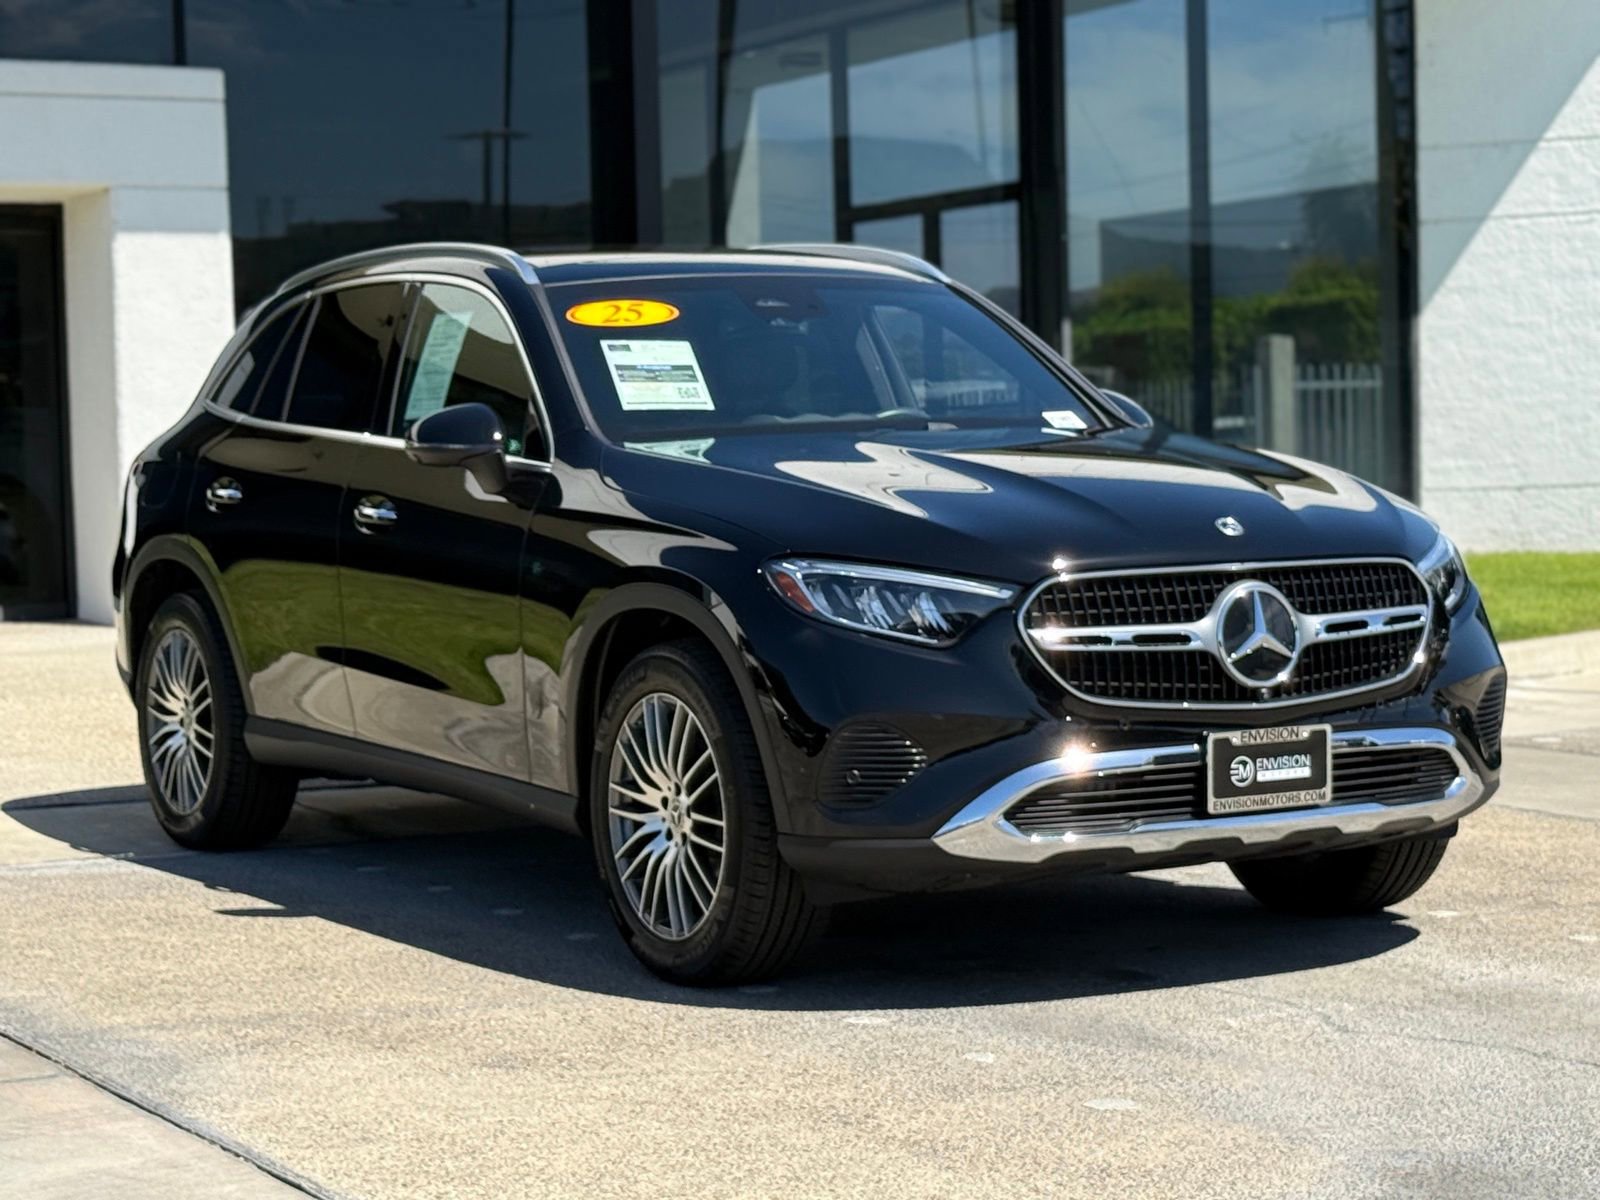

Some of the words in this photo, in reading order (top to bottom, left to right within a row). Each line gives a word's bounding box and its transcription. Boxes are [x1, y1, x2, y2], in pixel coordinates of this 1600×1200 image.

[602, 303, 643, 323] 25
[1240, 726, 1300, 743] ENVISION
[1256, 754, 1311, 770] ENVISION
[1213, 790, 1326, 811] ENVISIONMOTORS.COM
